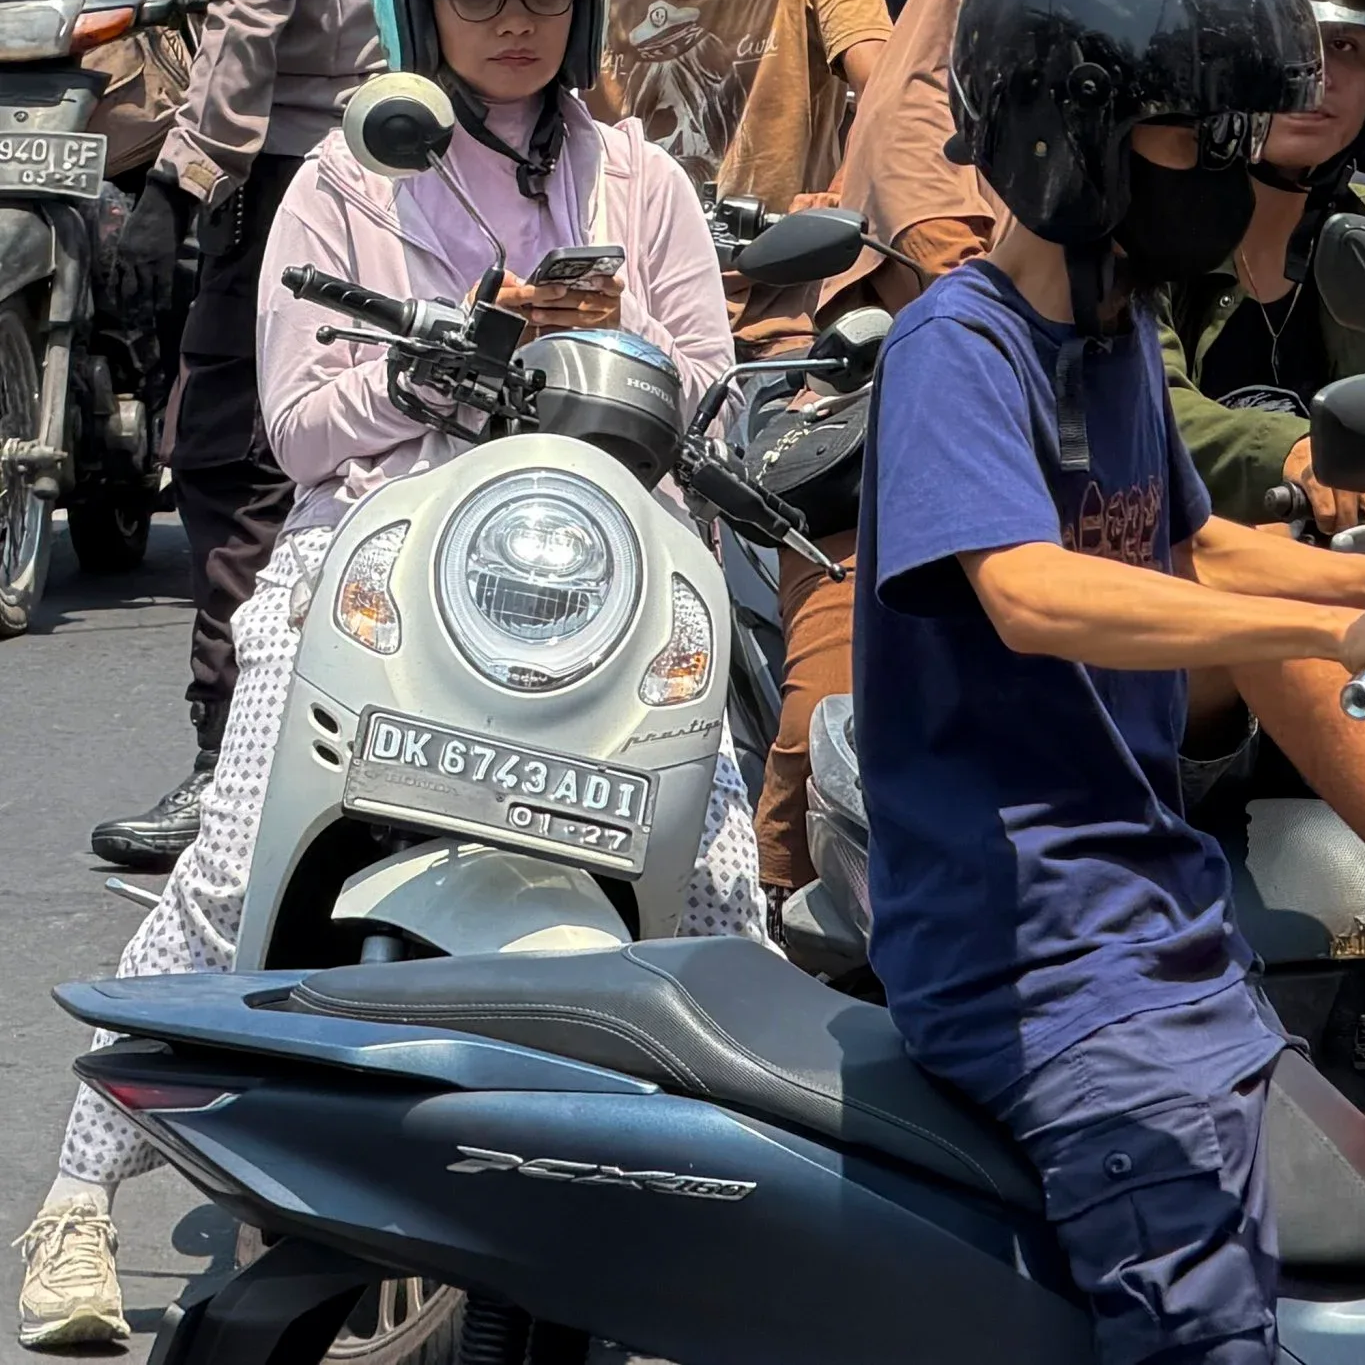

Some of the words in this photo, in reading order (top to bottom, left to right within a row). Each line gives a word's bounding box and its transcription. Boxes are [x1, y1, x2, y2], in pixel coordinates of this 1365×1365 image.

[626, 377, 677, 412] HONDA
[373, 722, 433, 767] DK
[439, 739, 549, 794] 6743
[550, 769, 636, 817] ADI
